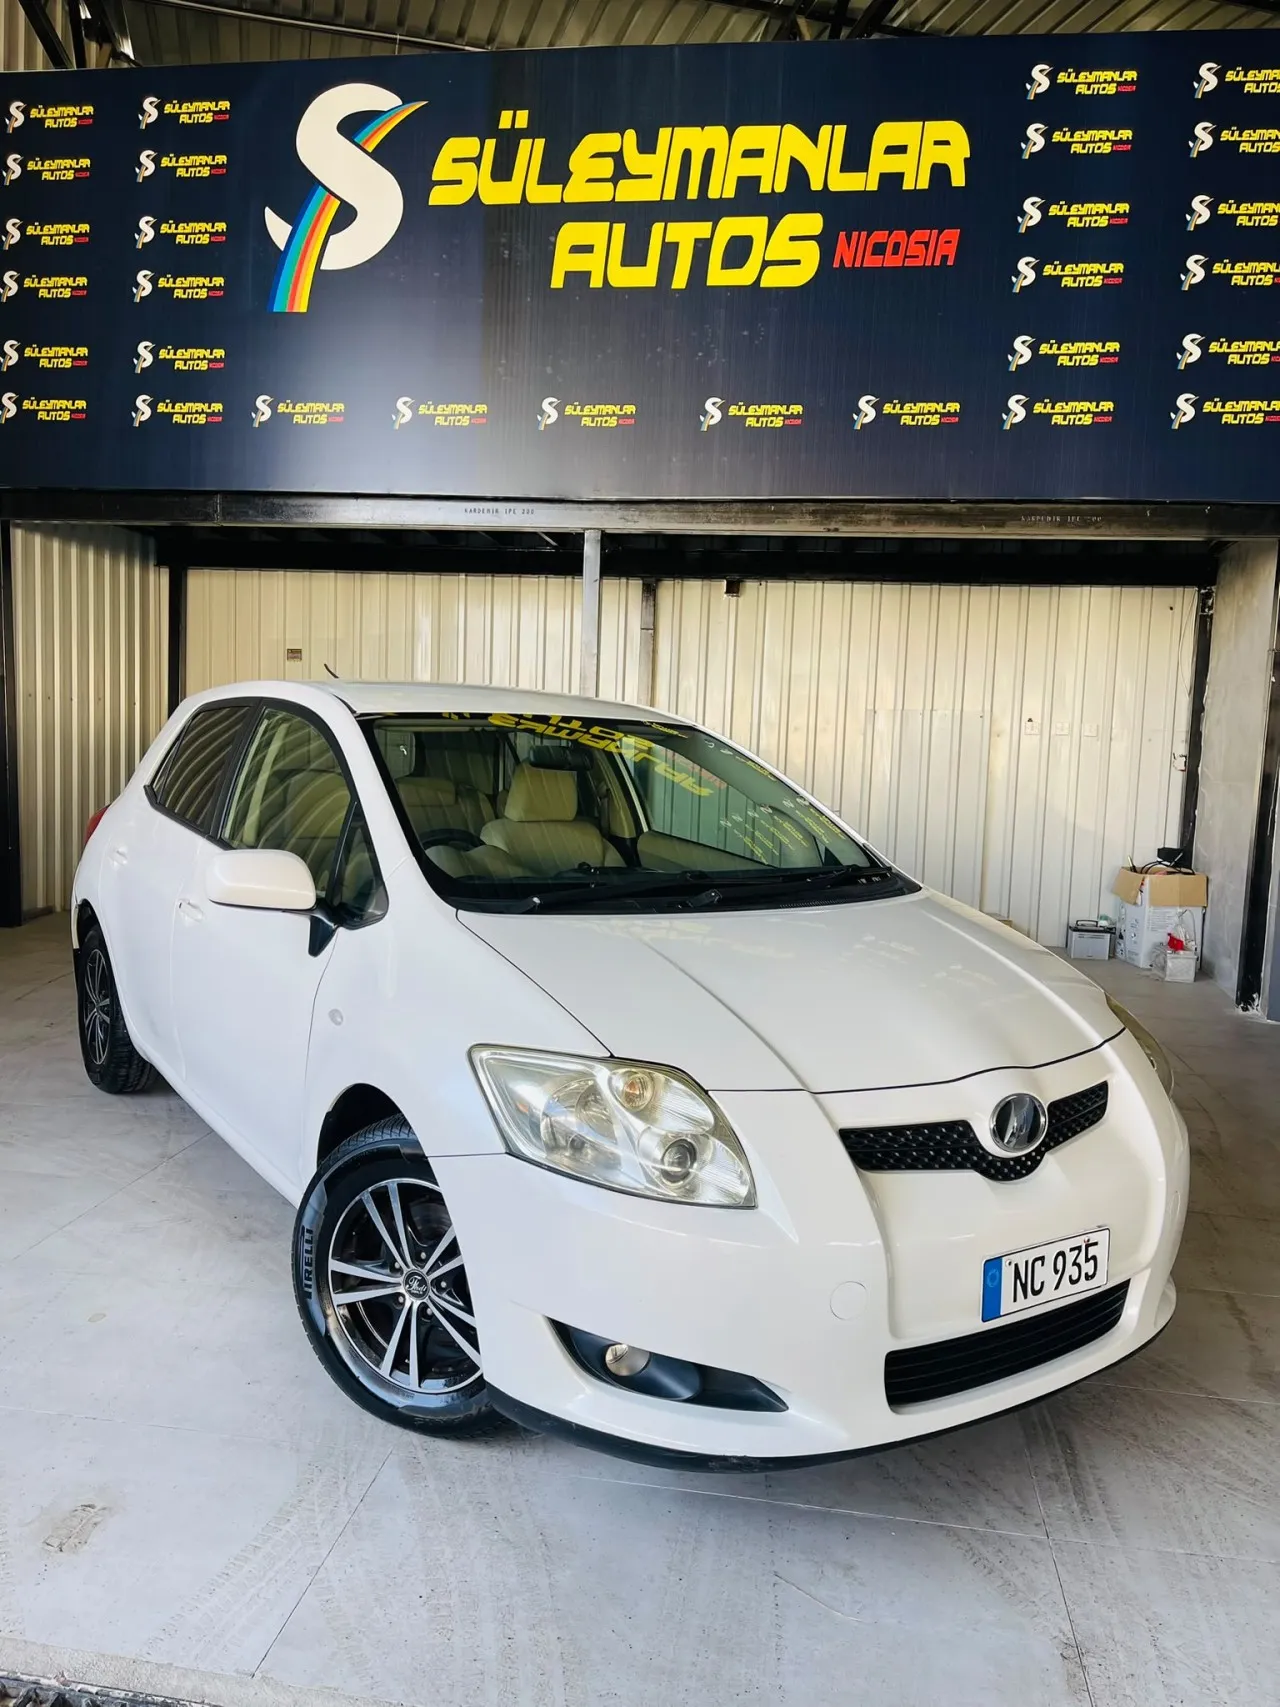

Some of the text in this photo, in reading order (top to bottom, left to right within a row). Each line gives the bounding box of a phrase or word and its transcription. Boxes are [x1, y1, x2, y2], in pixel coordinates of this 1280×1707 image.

[1076, 83, 1117, 94] AUTOS
[45, 117, 77, 127] AUTOS
[180, 113, 213, 123] AUTOS
[1071, 142, 1112, 153] AUTOS
[428, 110, 971, 206] SÜLEYMANLAR
[42, 170, 74, 180] AUTOS
[177, 167, 210, 177] AUTOS
[1067, 216, 1109, 227] AUTOS
[1237, 215, 1278, 226] AUTOS
[41, 235, 73, 245] AUTOS
[176, 234, 209, 244] AUTOS
[550, 212, 960, 289] AUTOS NICOSIA
[1061, 275, 1103, 287] AUTOS
[1231, 275, 1273, 286] AUTOS
[39, 288, 71, 298] AUTOS
[174, 288, 207, 298] AUTOS
[39, 358, 72, 368] AUTOS
[1057, 354, 1099, 366] AUTOS
[1228, 353, 1270, 364] AUTOS
[175, 360, 208, 370] AUTOS
[38, 411, 70, 420] AUTOS
[173, 414, 206, 424] AUTOS
[293, 414, 328, 424] AUTOS
[435, 416, 470, 426] AUTOS
[901, 414, 940, 425] AUTOS
[1052, 414, 1093, 425] AUTOS
[1222, 413, 1264, 424] AUTOS
[581, 416, 617, 427] AUTOS
[746, 416, 784, 427] AUTOS
[1012, 1241, 1099, 1303] NC 935
